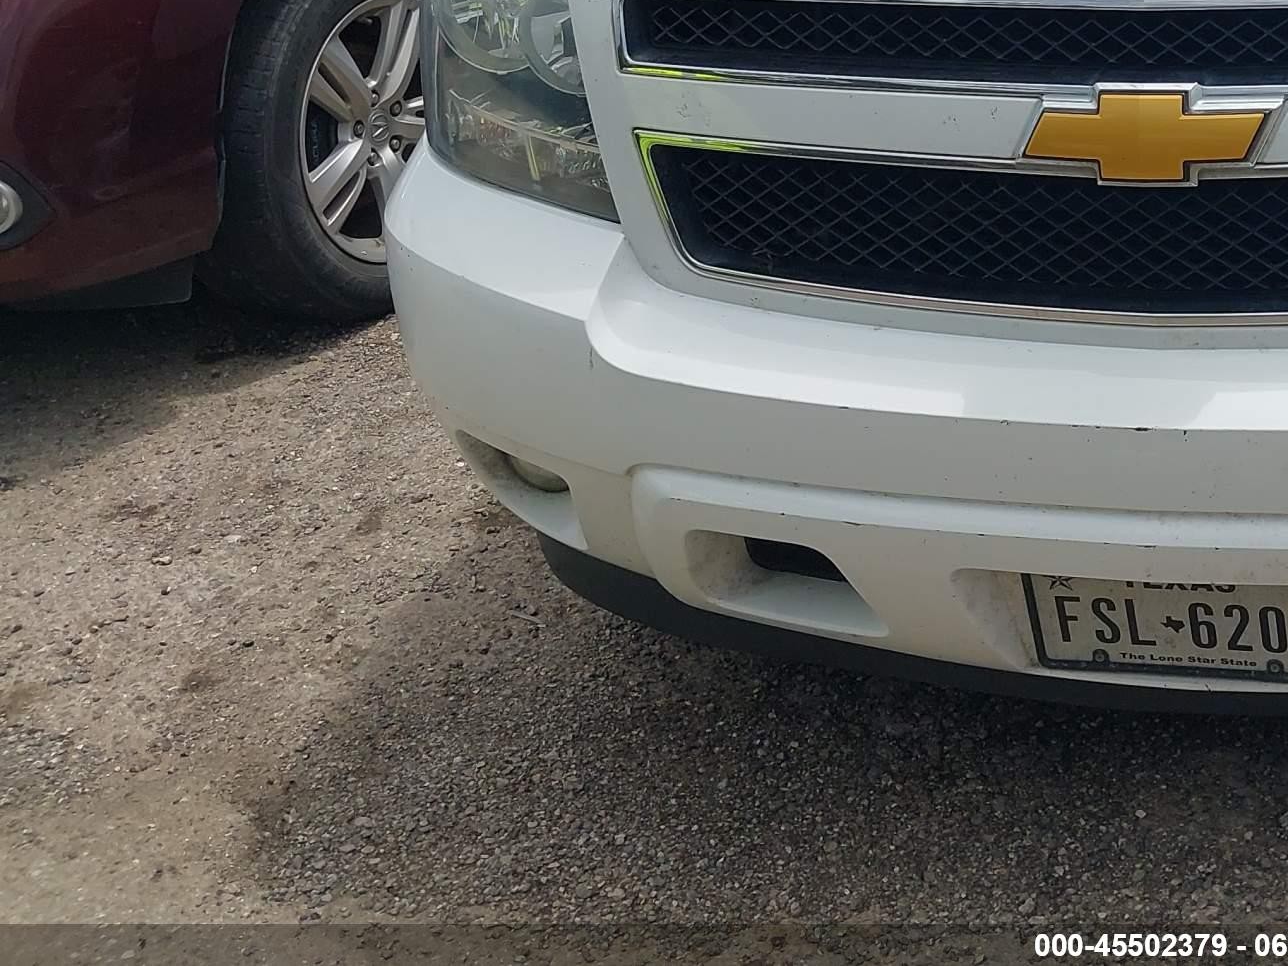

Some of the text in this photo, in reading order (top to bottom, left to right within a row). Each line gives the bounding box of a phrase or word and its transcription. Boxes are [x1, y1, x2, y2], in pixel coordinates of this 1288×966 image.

[1054, 596, 1157, 646] FSL
[1120, 652, 1257, 667] The Lone Star State
